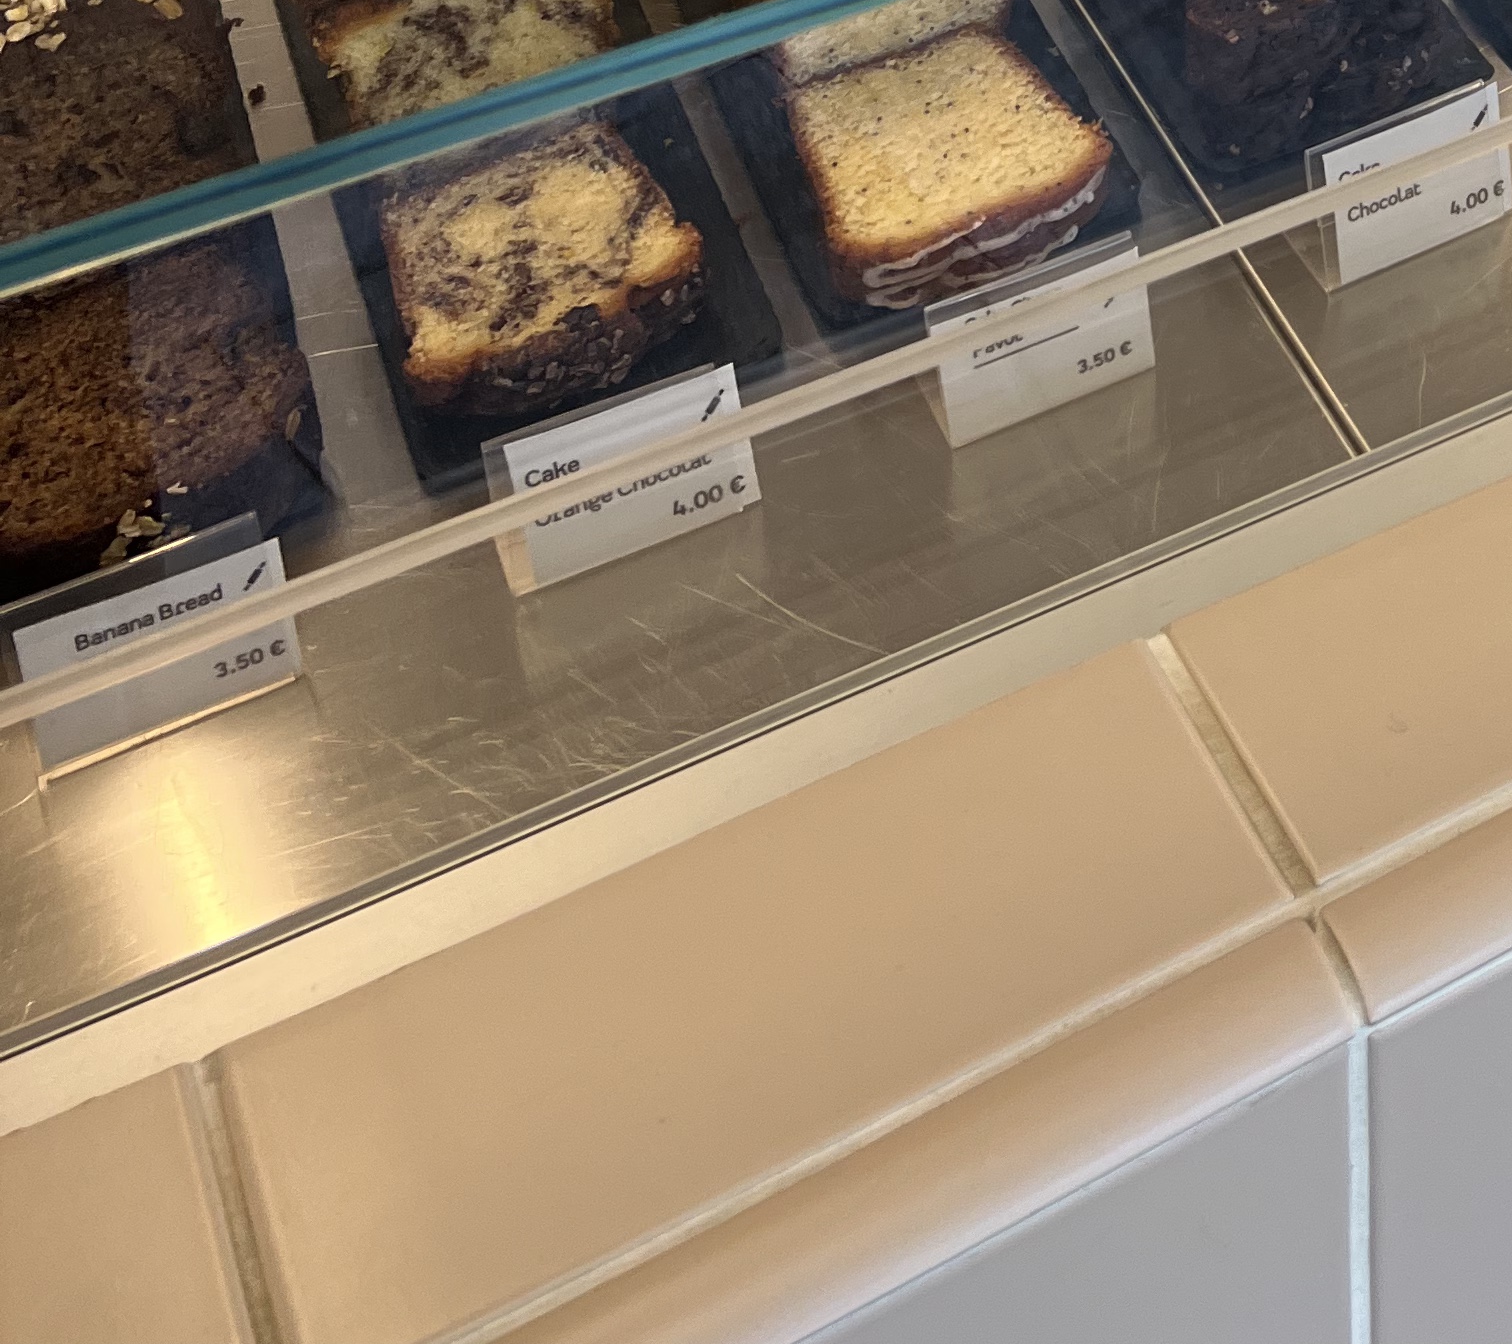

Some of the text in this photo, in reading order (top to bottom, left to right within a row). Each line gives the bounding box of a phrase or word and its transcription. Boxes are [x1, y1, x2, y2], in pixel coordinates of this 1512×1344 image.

[1347, 182, 1423, 223] Chocolat
[1450, 180, 1505, 216] 4.00 €
[1077, 340, 1133, 375] 3.50 €
[524, 457, 581, 489] Cake
[672, 475, 747, 517] 4.00 €
[74, 582, 223, 652] Banana Bread
[213, 639, 286, 680] 3.50 €
